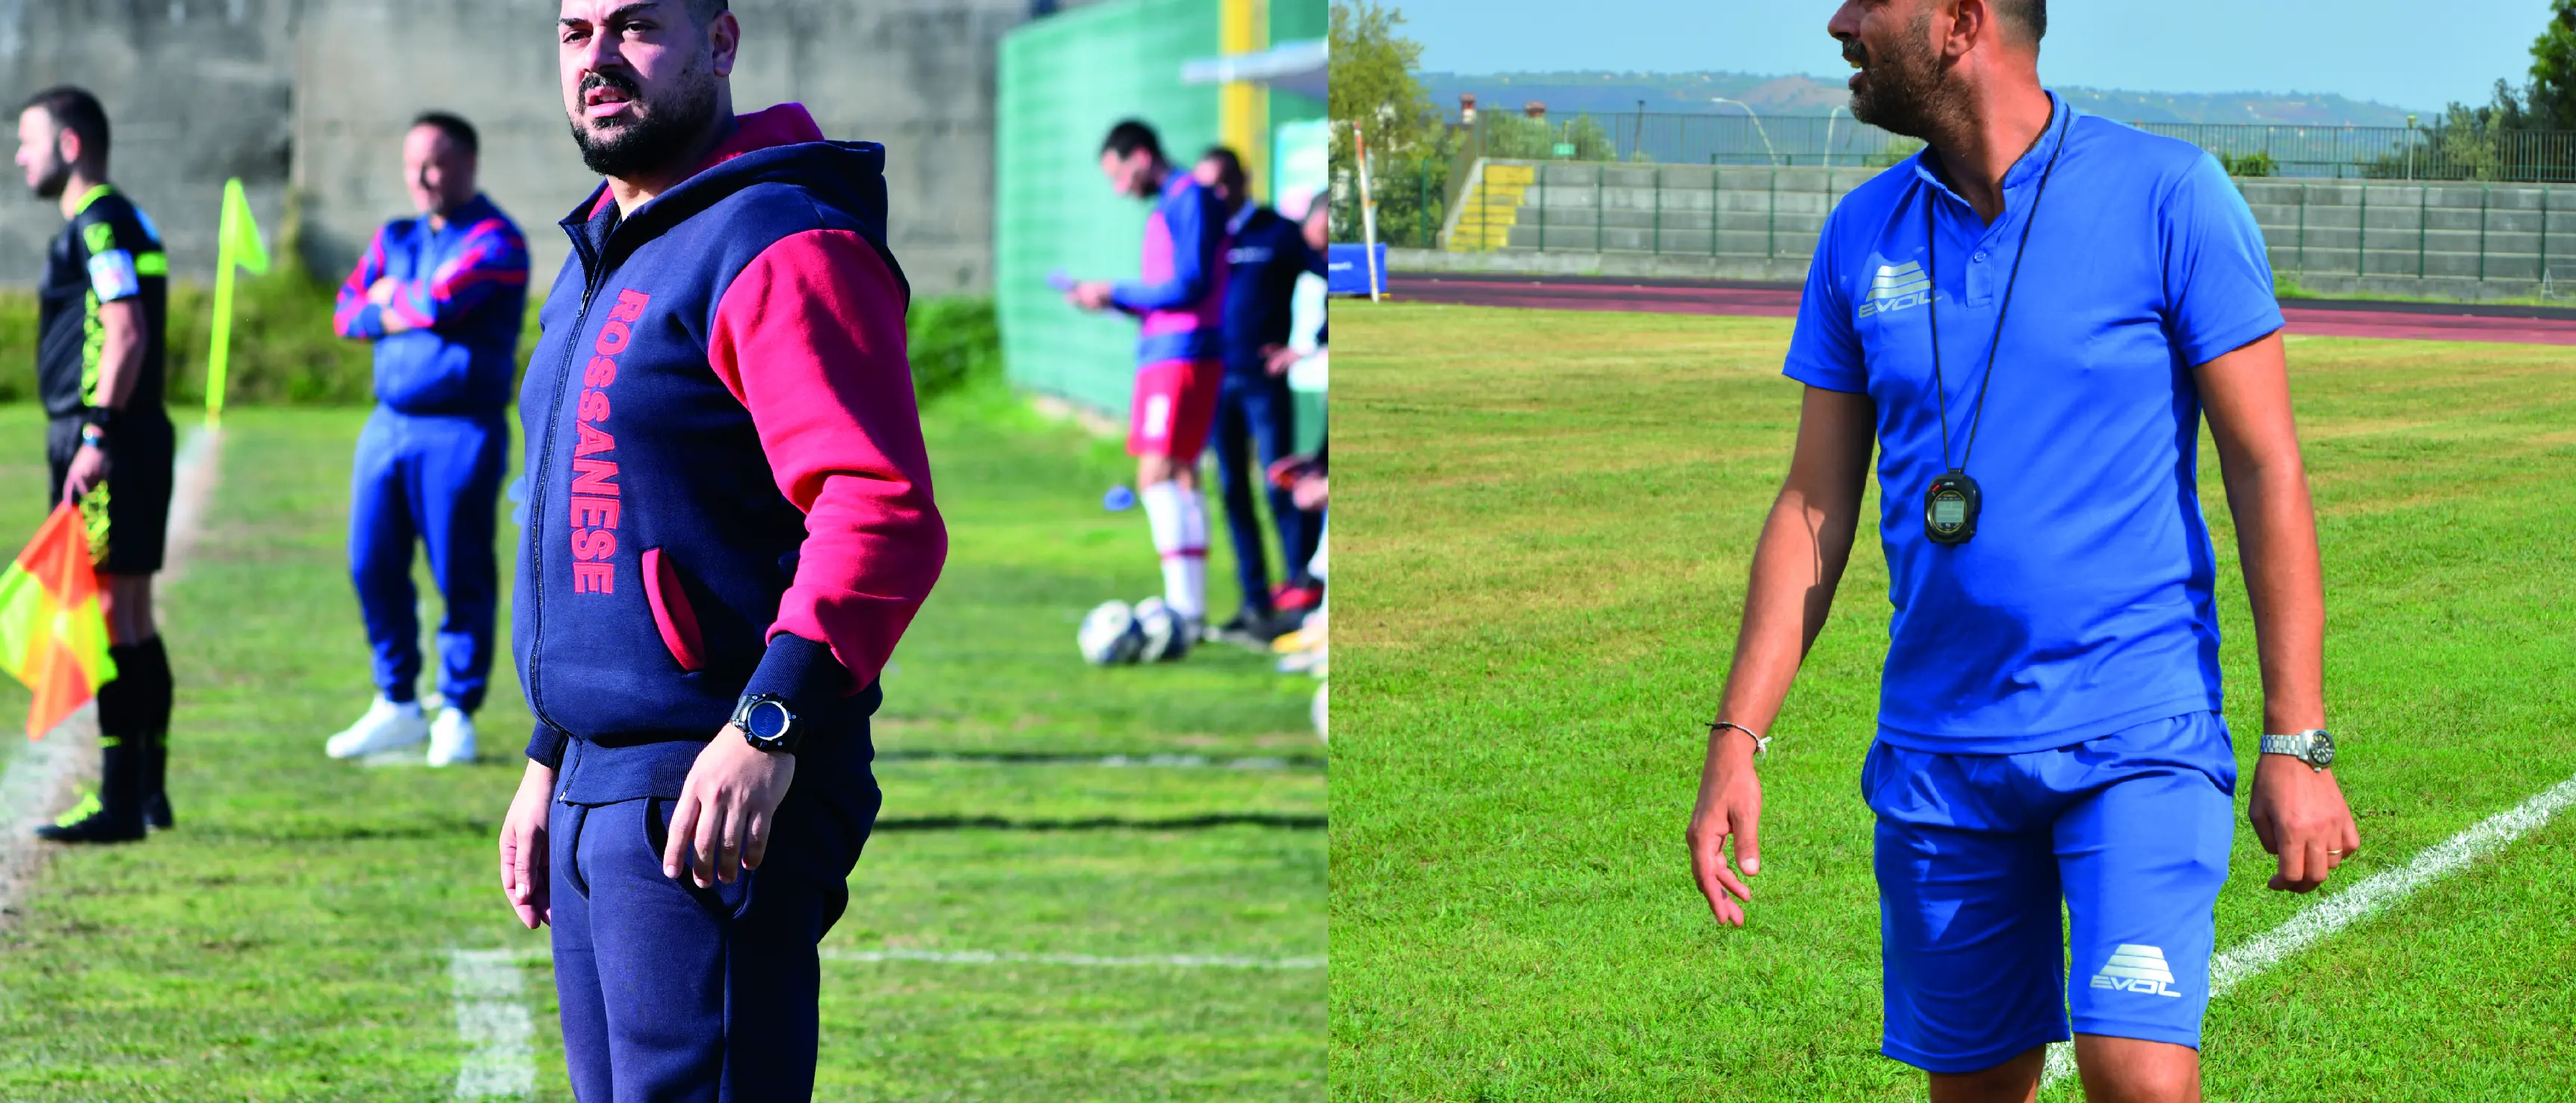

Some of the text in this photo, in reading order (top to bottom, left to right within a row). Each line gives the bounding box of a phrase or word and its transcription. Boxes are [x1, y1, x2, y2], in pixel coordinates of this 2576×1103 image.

[1858, 291, 1942, 318] EVOL
[570, 288, 650, 594] ROSSANESE
[2089, 974, 2181, 997] EVOL
